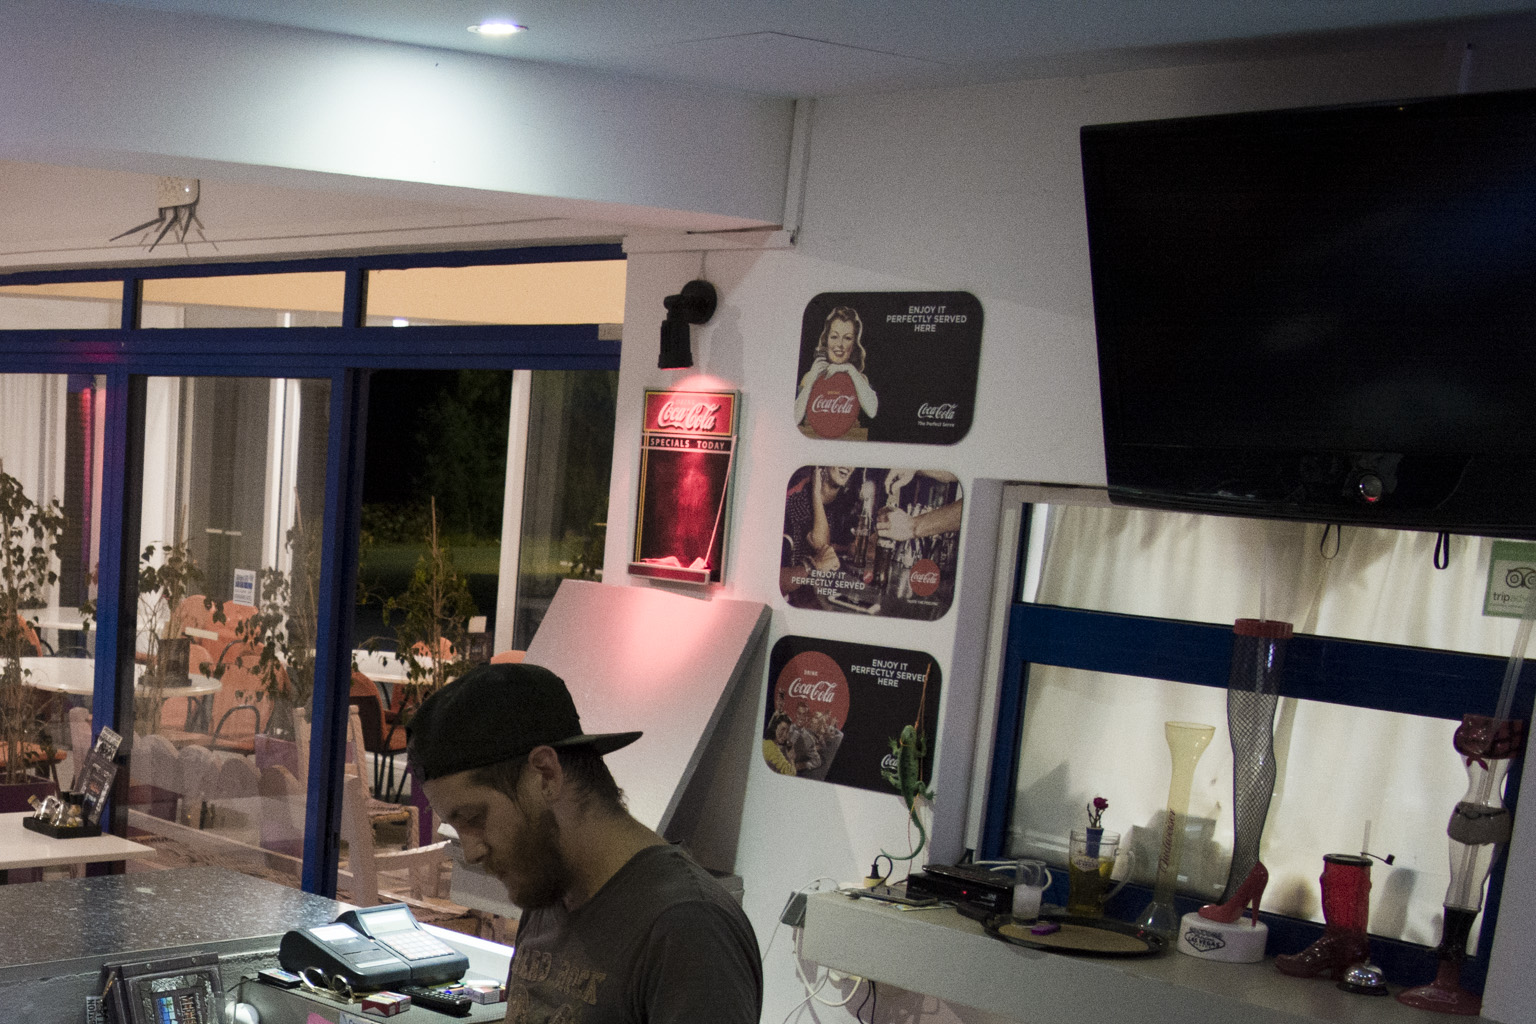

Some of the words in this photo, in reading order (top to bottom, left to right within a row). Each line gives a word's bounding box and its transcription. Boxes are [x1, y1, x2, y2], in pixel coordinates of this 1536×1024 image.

[908, 306, 936, 314] ENJOY
[938, 306, 946, 314] IT
[886, 315, 932, 323] PERFECTLY
[934, 315, 967, 323] SERVED
[914, 324, 936, 332] HERE
[650, 438, 690, 448] SPECIALS
[697, 440, 725, 450] TODAY
[811, 570, 837, 579] ENJOY
[838, 572, 846, 580] IT
[791, 577, 833, 588] PERFECTLY
[834, 580, 864, 590] SERVED
[816, 588, 837, 596] HERE
[872, 658, 898, 670] ENJOY
[900, 662, 908, 670] IT
[851, 665, 894, 678] PERFECTLY
[878, 678, 899, 688] HERE
